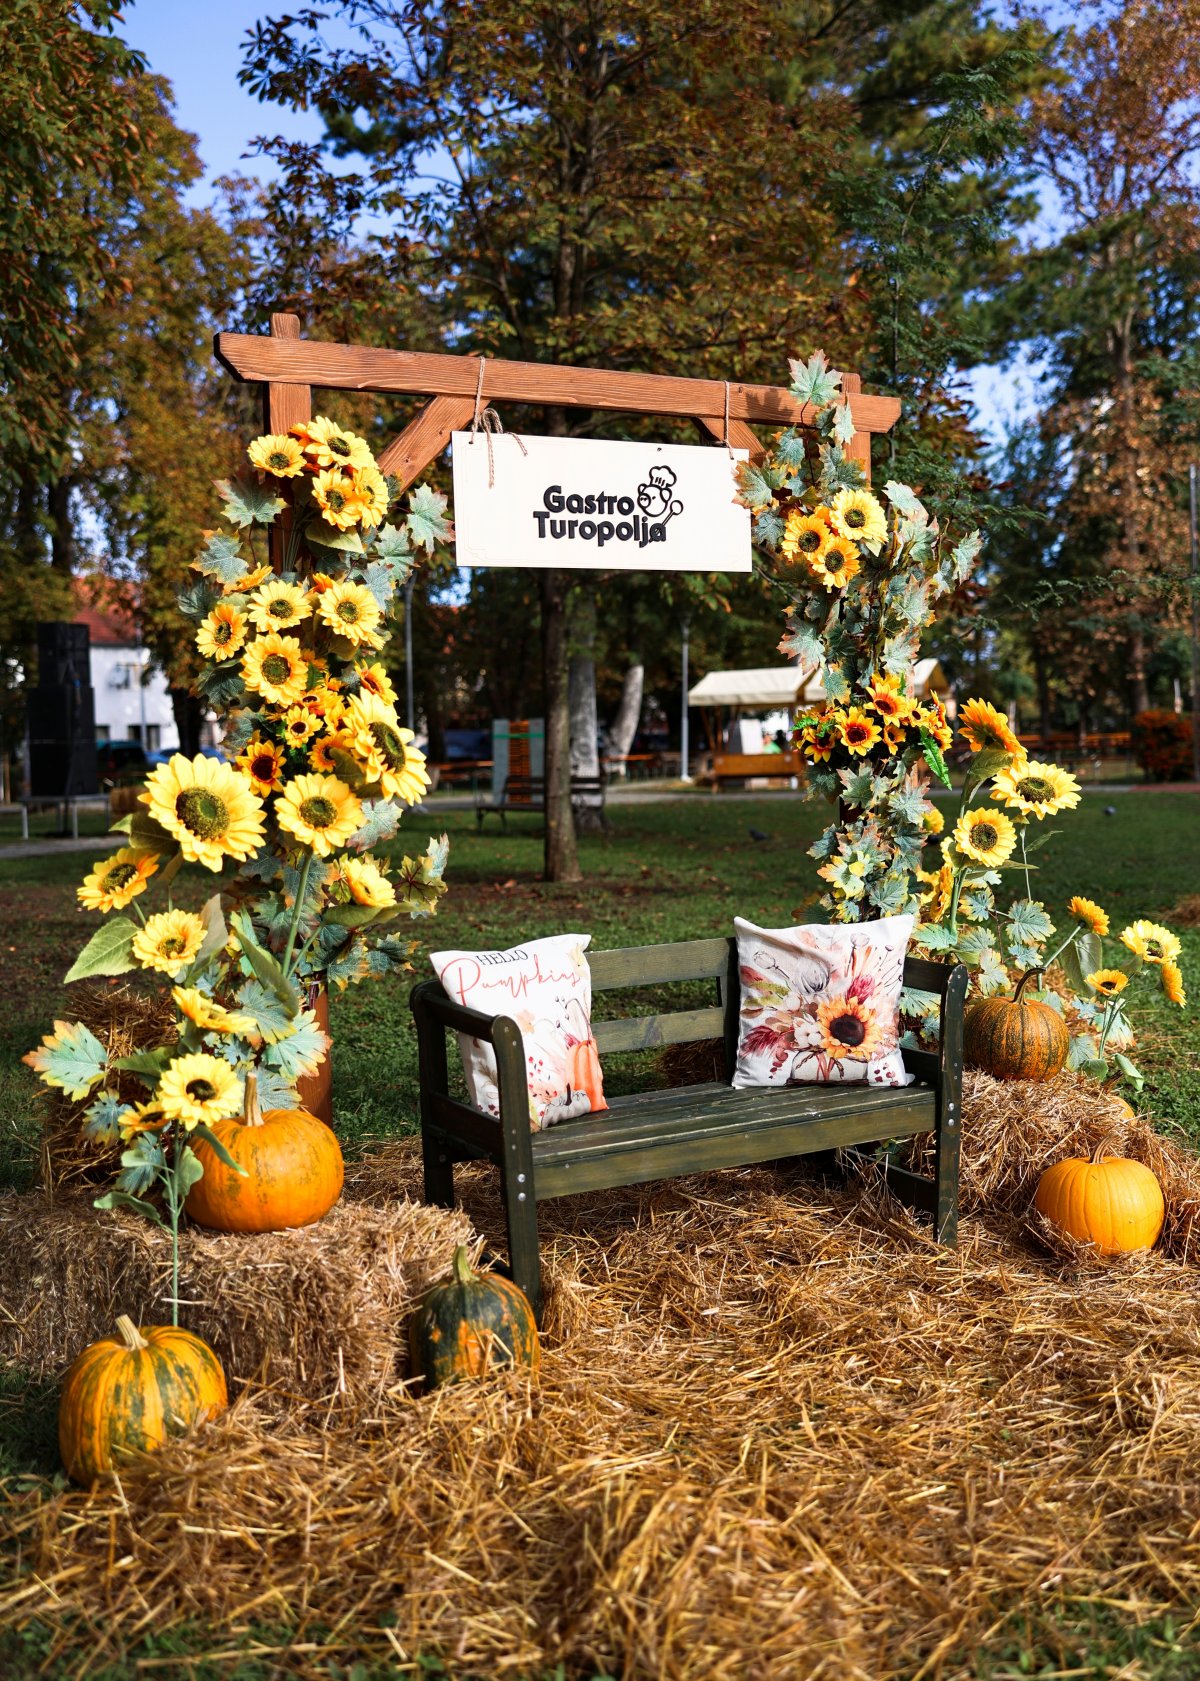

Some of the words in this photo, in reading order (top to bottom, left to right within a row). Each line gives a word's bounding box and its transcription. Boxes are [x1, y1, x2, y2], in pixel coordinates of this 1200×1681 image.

[543, 485, 635, 515] Gastro
[532, 510, 667, 548] Turopolja
[475, 949, 529, 966] HELLO
[440, 953, 581, 1008] Pumpkins
